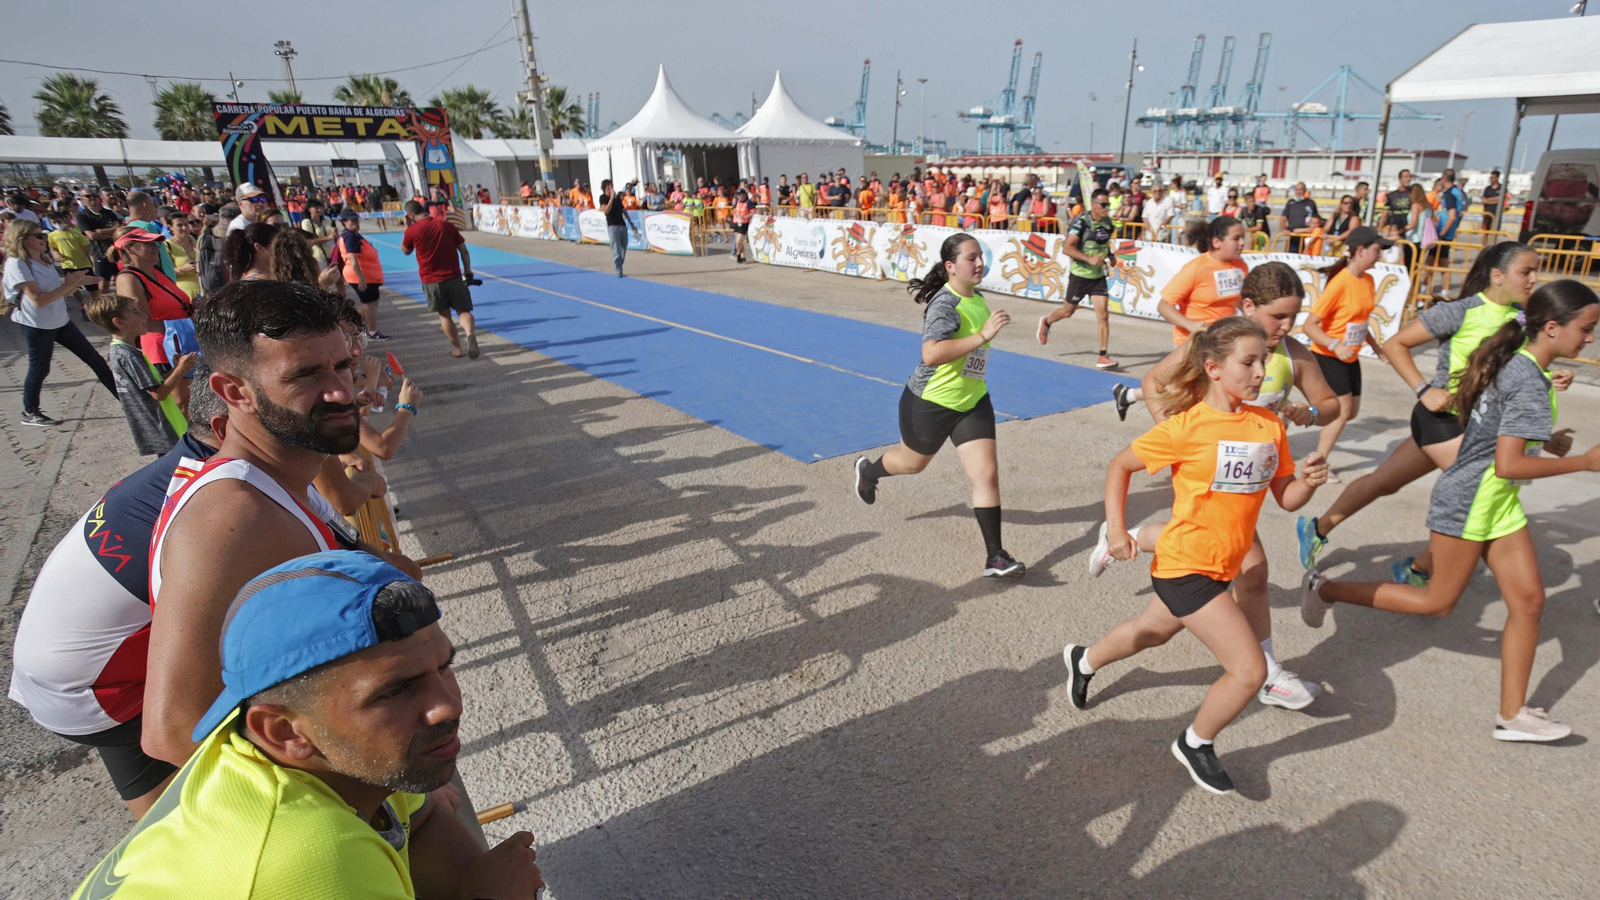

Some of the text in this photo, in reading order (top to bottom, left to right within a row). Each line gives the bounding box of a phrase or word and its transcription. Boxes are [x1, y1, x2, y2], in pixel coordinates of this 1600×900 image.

[216, 104, 406, 118] CARRERA POPULAR PUERTO BAHÍA DE ALGECIRAS
[264, 116, 410, 137] META
[966, 356, 986, 371] 309
[1224, 460, 1254, 479] 164
[87, 486, 133, 573] PAÑA
